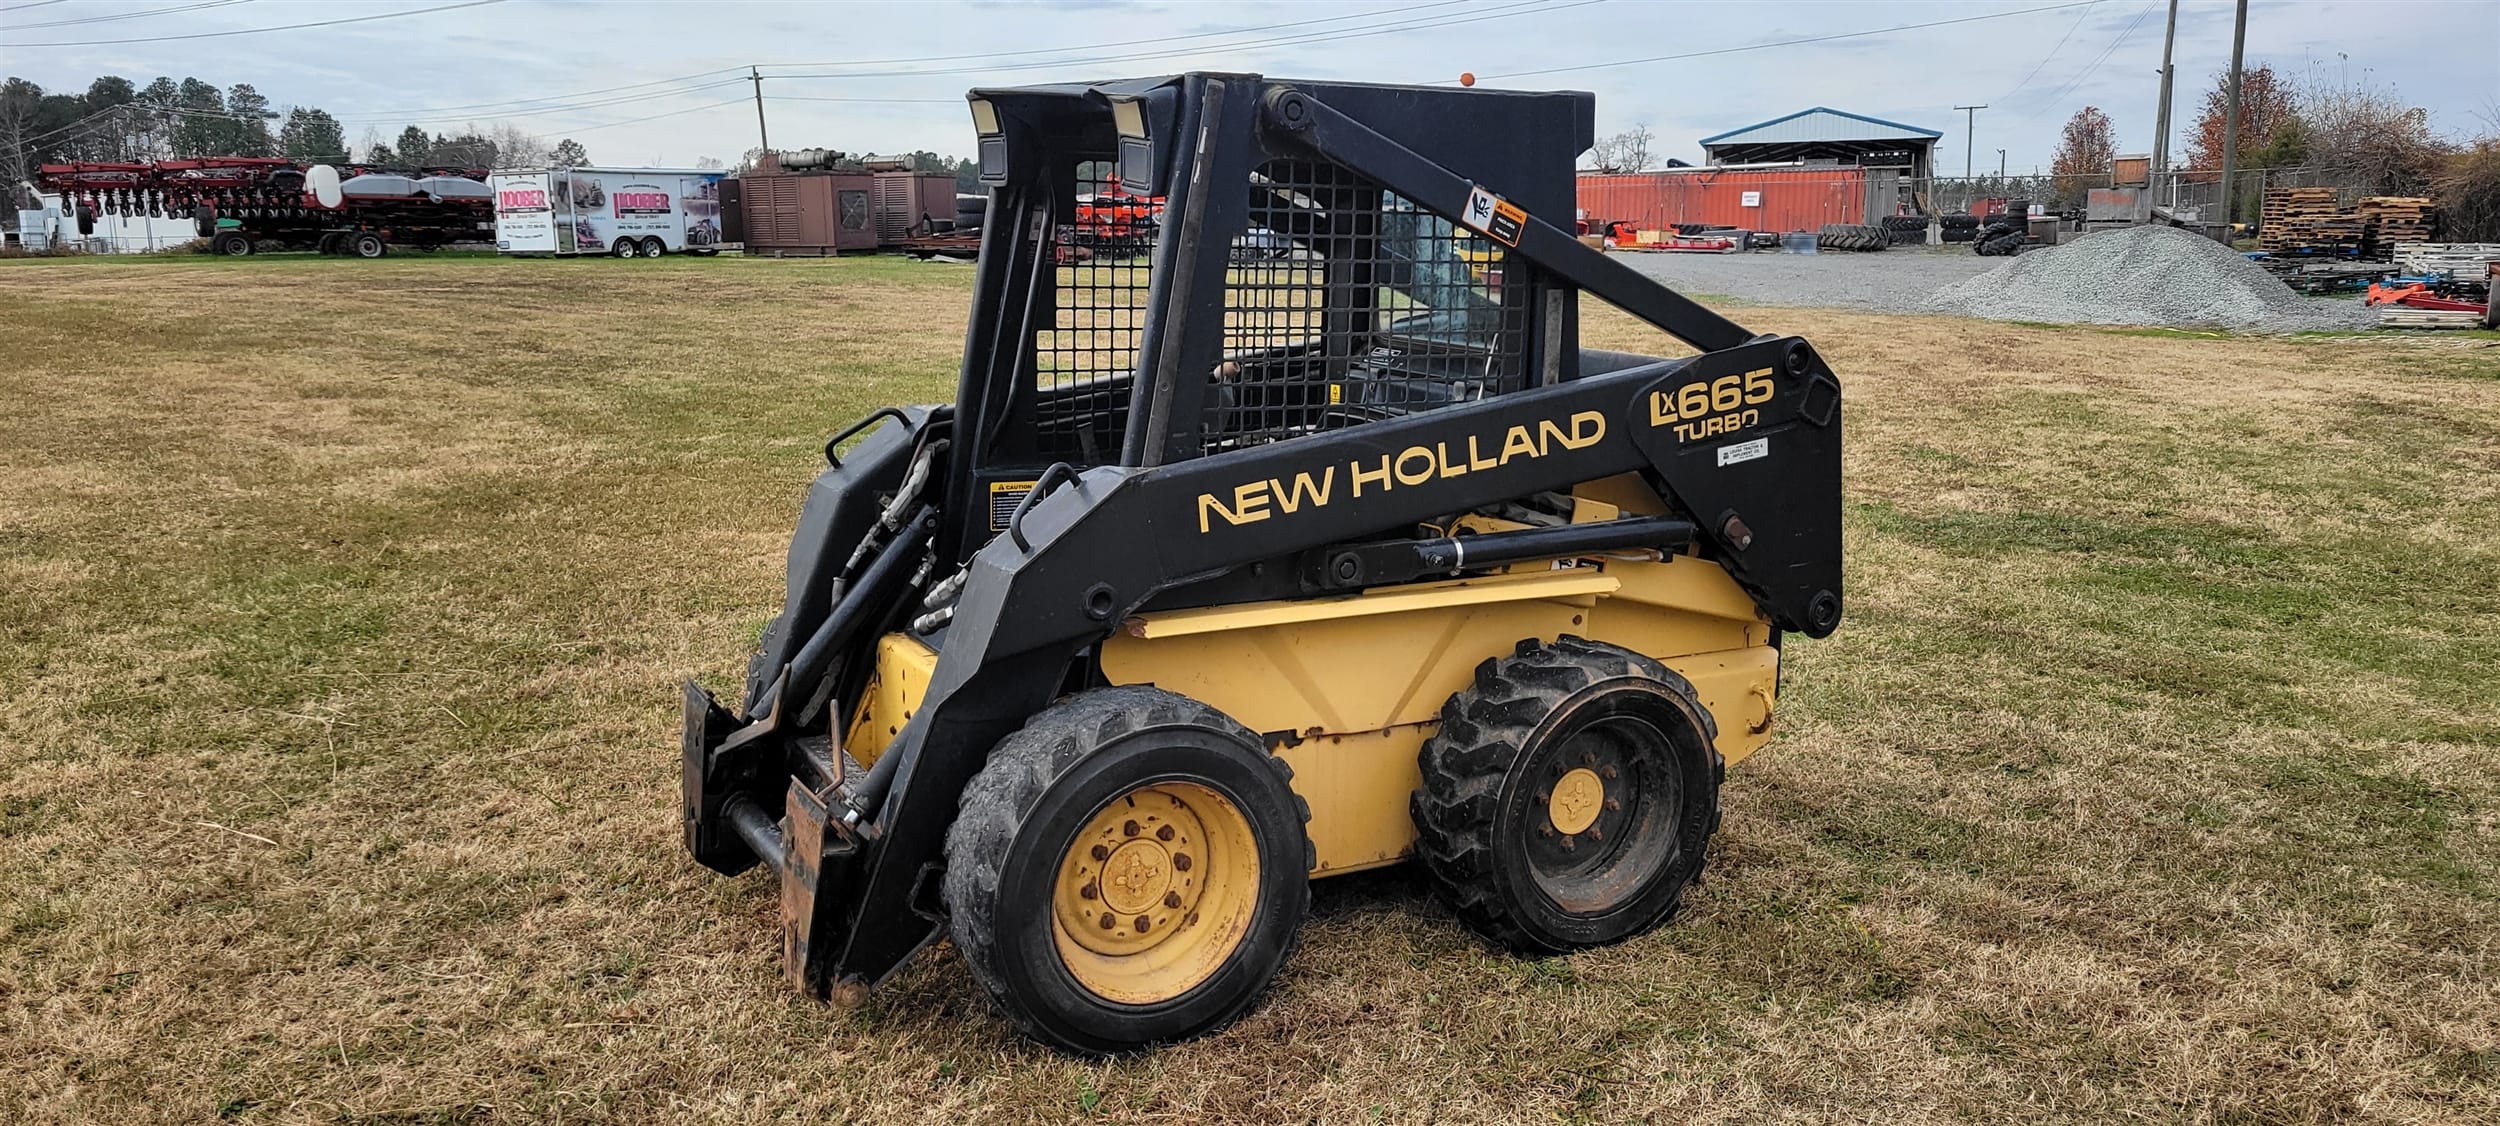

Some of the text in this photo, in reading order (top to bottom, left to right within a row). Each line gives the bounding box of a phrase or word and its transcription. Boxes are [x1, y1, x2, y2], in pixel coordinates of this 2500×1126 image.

[499, 190, 546, 218] HOOBER
[613, 192, 670, 218] HOOBER
[1673, 408, 1759, 443] TURBO
[1197, 410, 1607, 533] NEW HOLLAND
